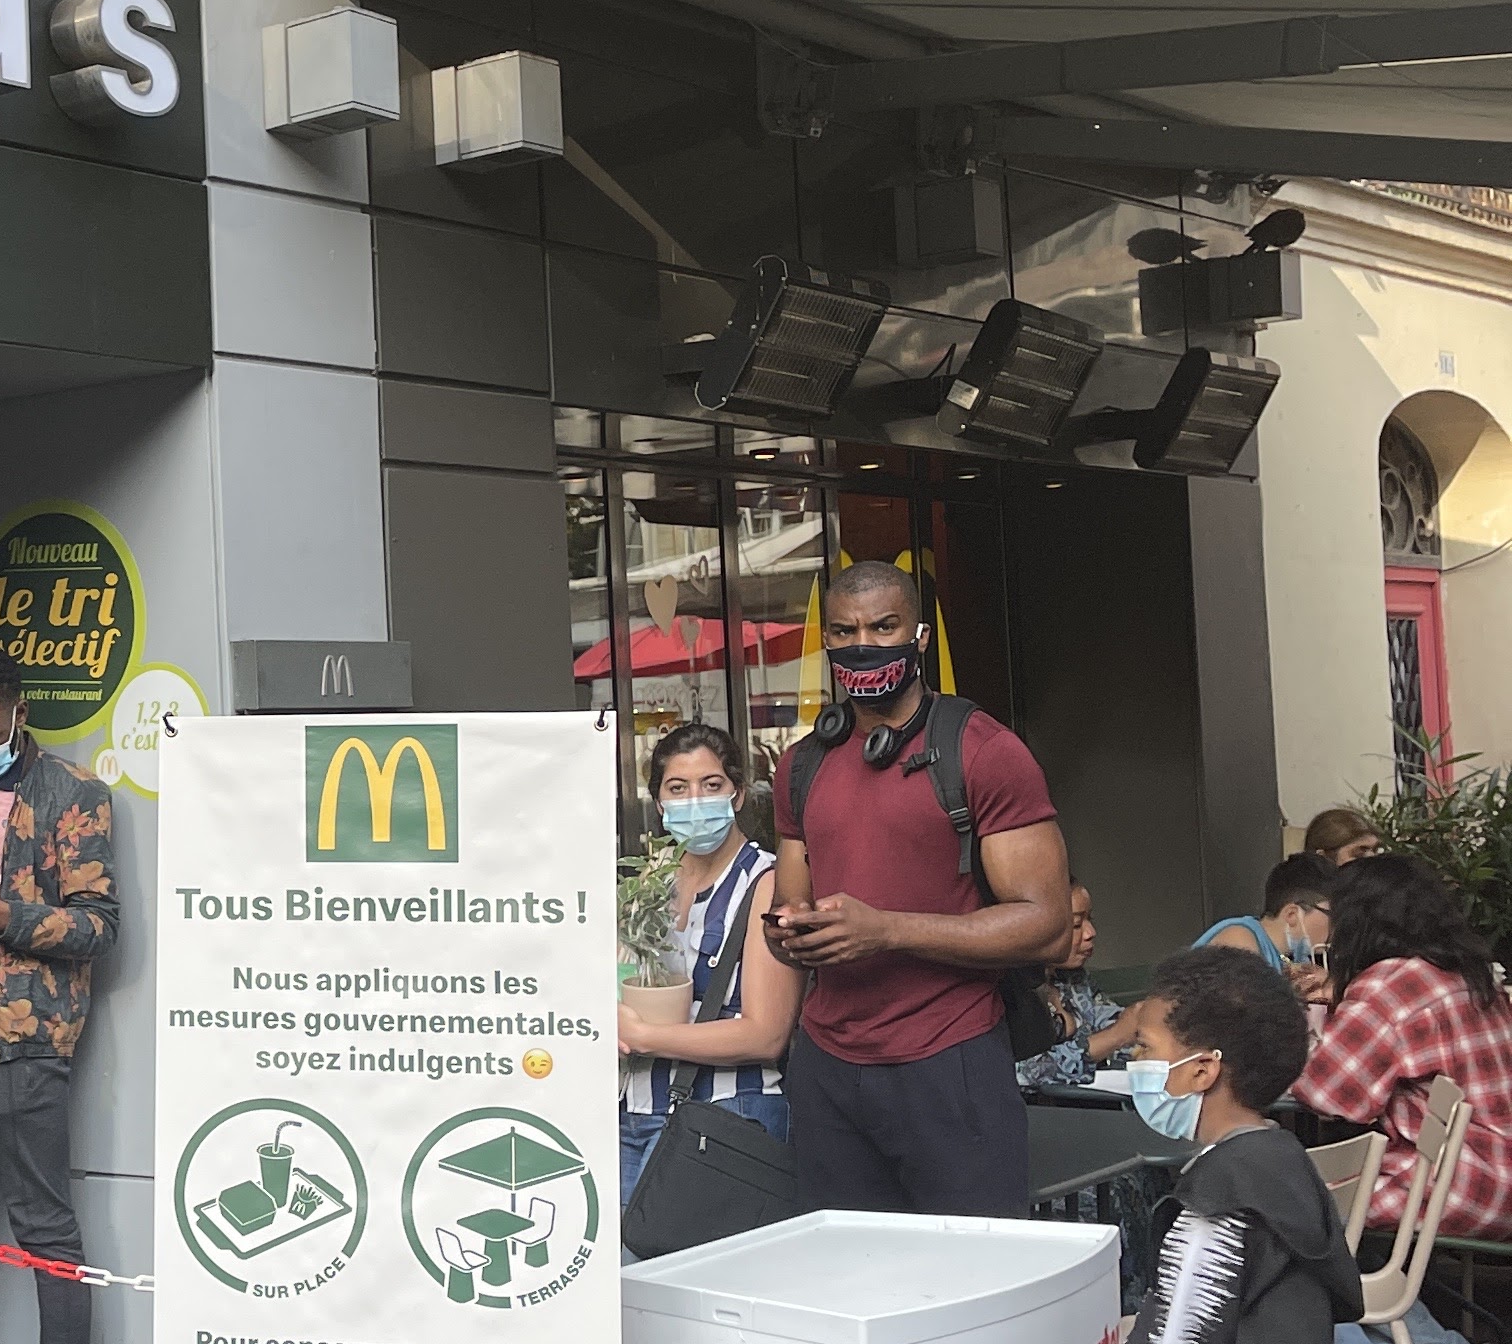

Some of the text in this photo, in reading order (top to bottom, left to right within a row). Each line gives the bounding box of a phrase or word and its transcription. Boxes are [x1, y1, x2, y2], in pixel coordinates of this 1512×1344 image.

[7, 536, 100, 565] Nouveau
[48, 572, 120, 627] tri
[51, 687, 103, 702] restaurant
[175, 887, 273, 921] Tous
[285, 886, 565, 924] Bienveillants
[232, 966, 539, 1000] Nous appliquons les
[169, 1008, 600, 1042] mesures gouvernementales,
[255, 1045, 514, 1081] soyez indulgents
[252, 1256, 346, 1299] SUR PLACE
[516, 1244, 593, 1308] TERRASSE
